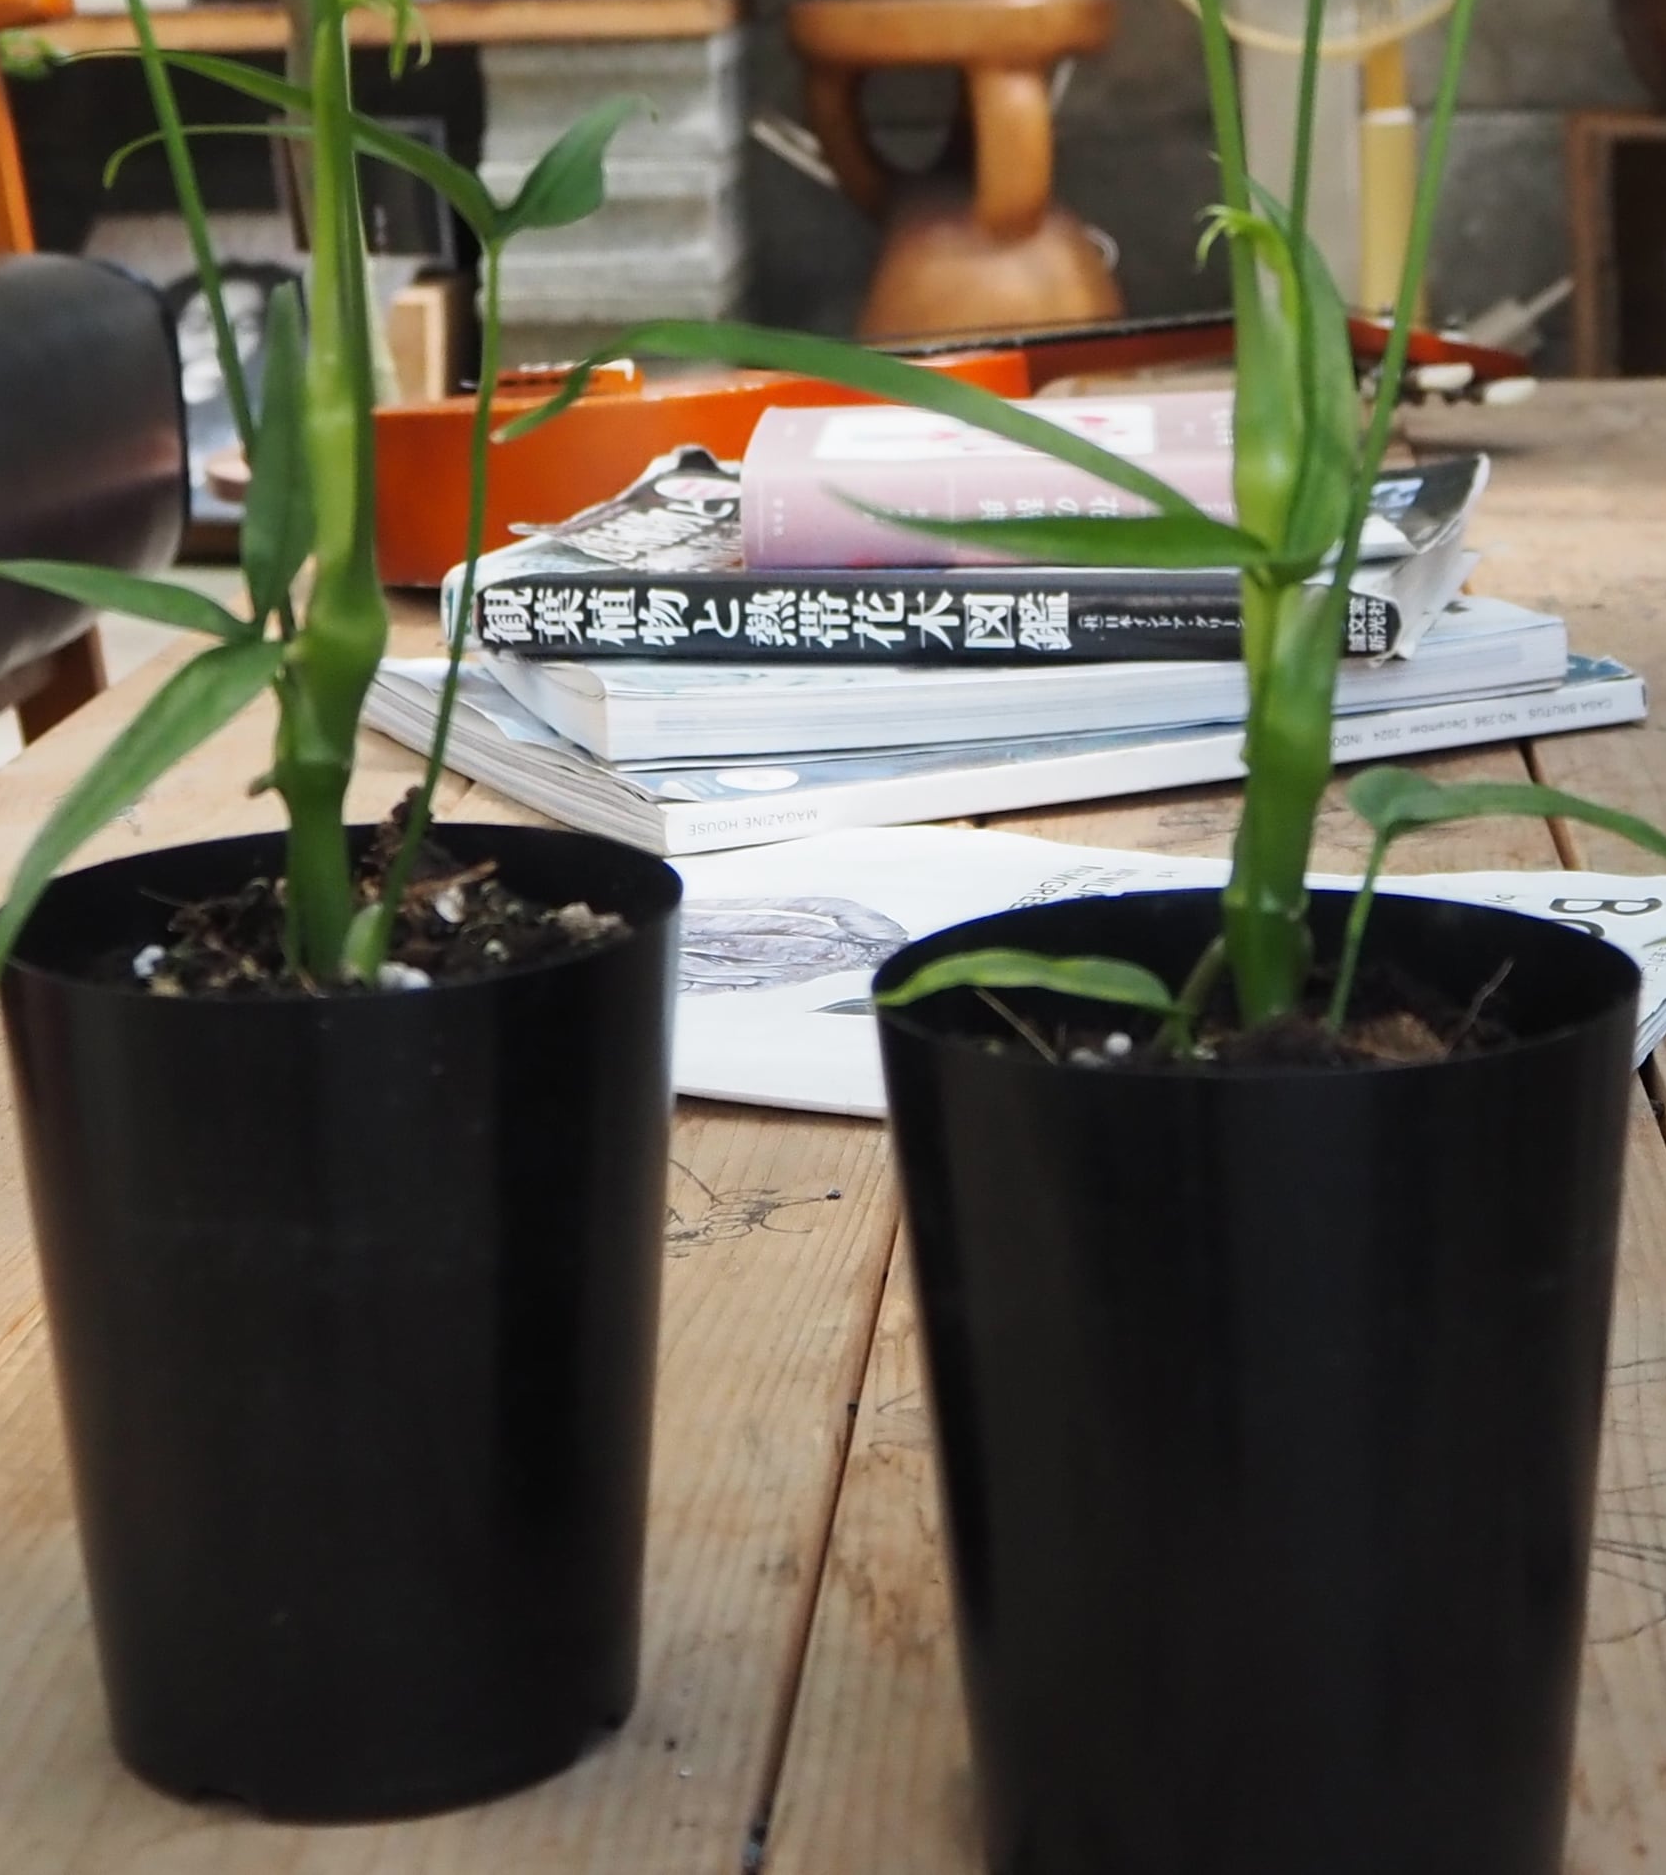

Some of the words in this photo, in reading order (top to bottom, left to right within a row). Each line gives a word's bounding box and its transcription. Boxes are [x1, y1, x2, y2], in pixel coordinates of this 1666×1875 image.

[482, 585, 1074, 653] 観葉植物と熱帯花木図鑑
[1374, 726, 1401, 741] 2024
[1406, 717, 1468, 735] December
[744, 808, 818, 828] MAGAZINE
[687, 820, 739, 837] HOUSE
